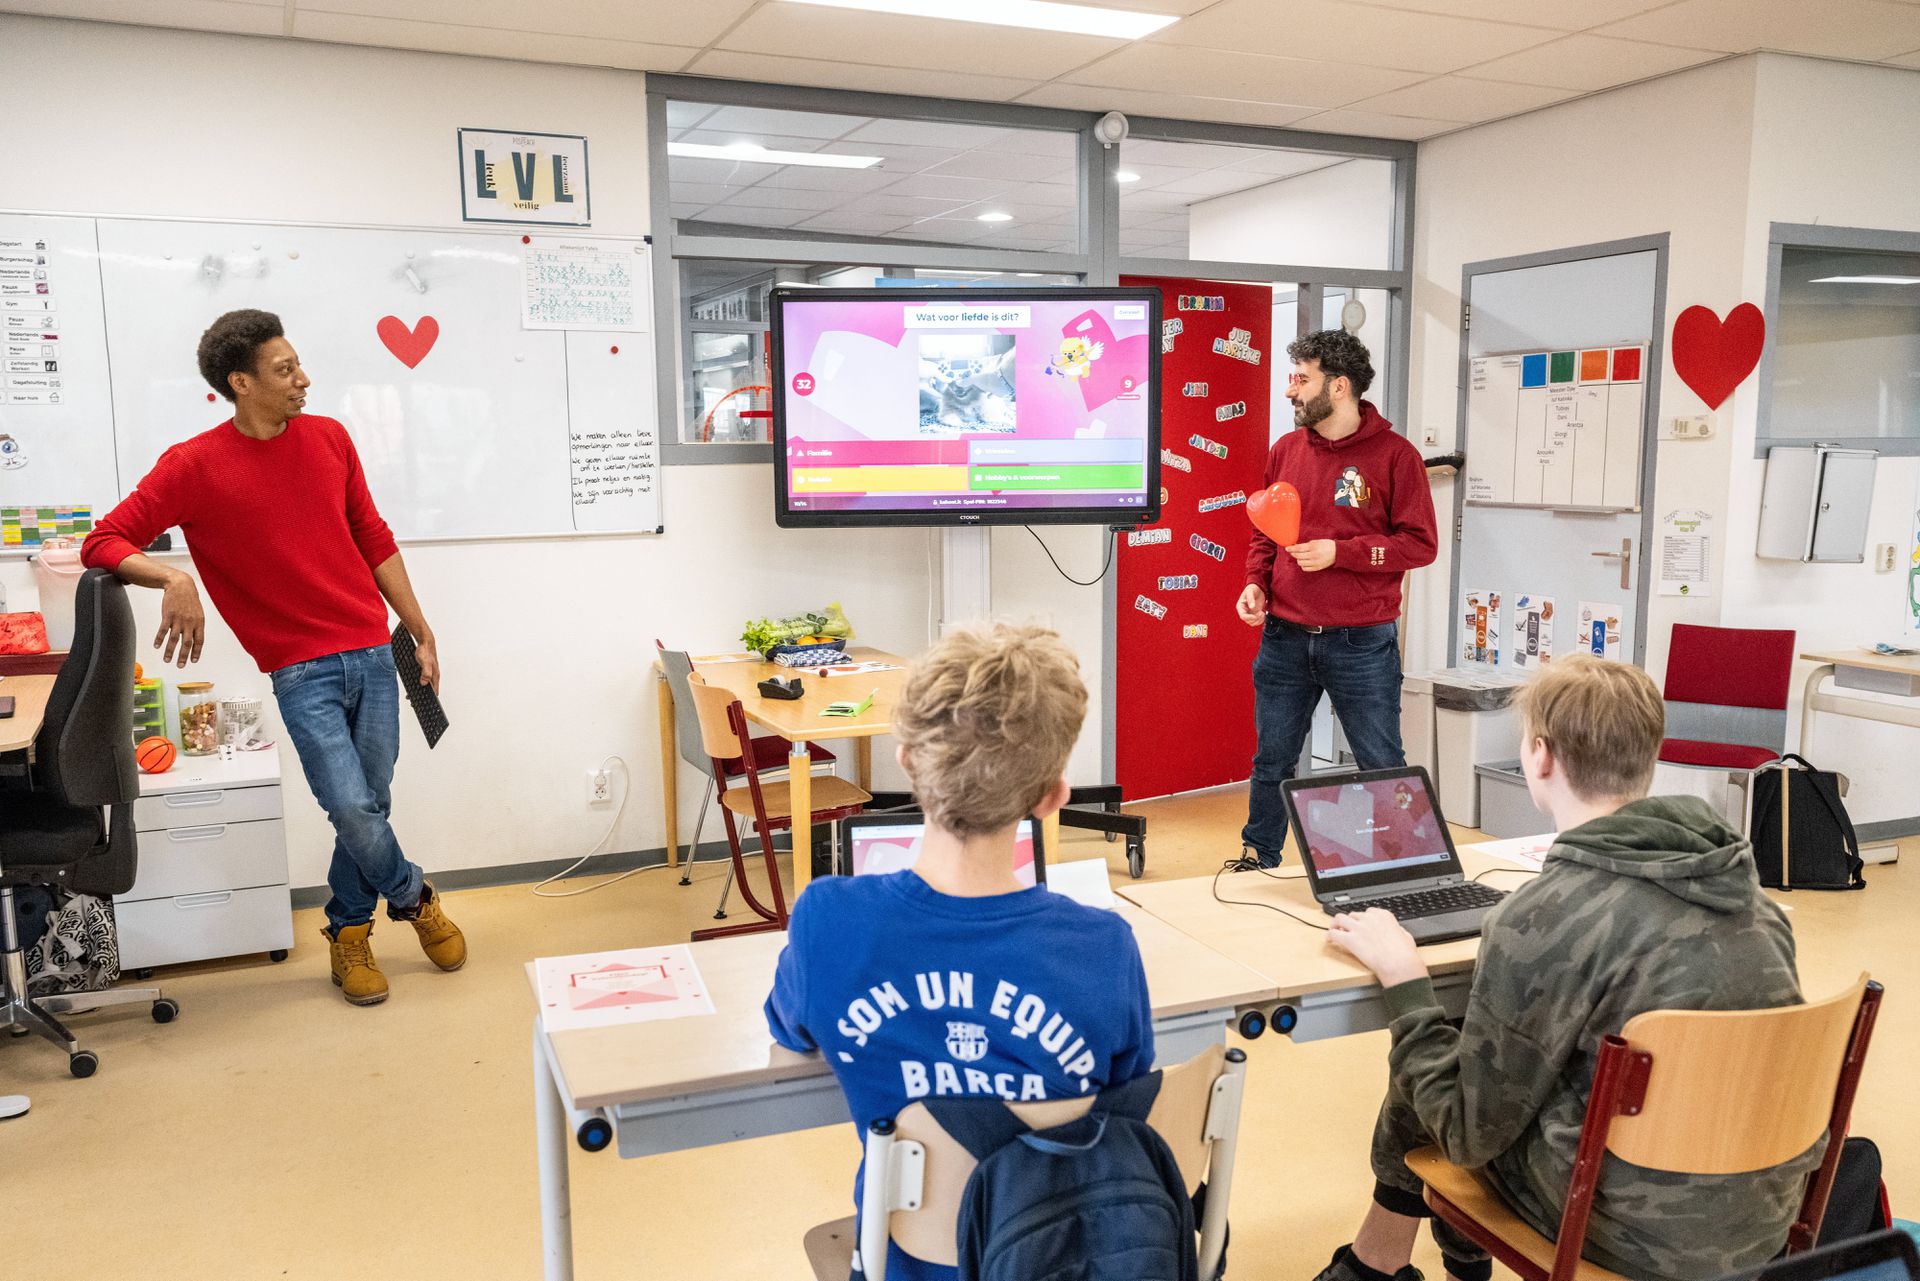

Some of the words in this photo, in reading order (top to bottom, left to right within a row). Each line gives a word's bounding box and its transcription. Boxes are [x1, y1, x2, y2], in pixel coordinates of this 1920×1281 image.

[486, 163, 496, 189] leuk
[513, 202, 540, 210] veilig
[916, 313, 936, 322] Wat
[938, 314, 959, 322] voor
[961, 312, 989, 322] liefde
[991, 313, 1000, 321] is
[1001, 312, 1020, 322] dit?
[796, 379, 812, 390] 32
[1124, 379, 1132, 389] 9
[571, 433, 581, 441] We
[610, 430, 632, 438] alleen
[1188, 433, 1228, 460] JAYDEN
[837, 981, 910, 1047] SOM
[915, 971, 974, 1010] UN
[990, 979, 1096, 1076] EQUIP
[901, 1060, 1047, 1101] BARÇA
